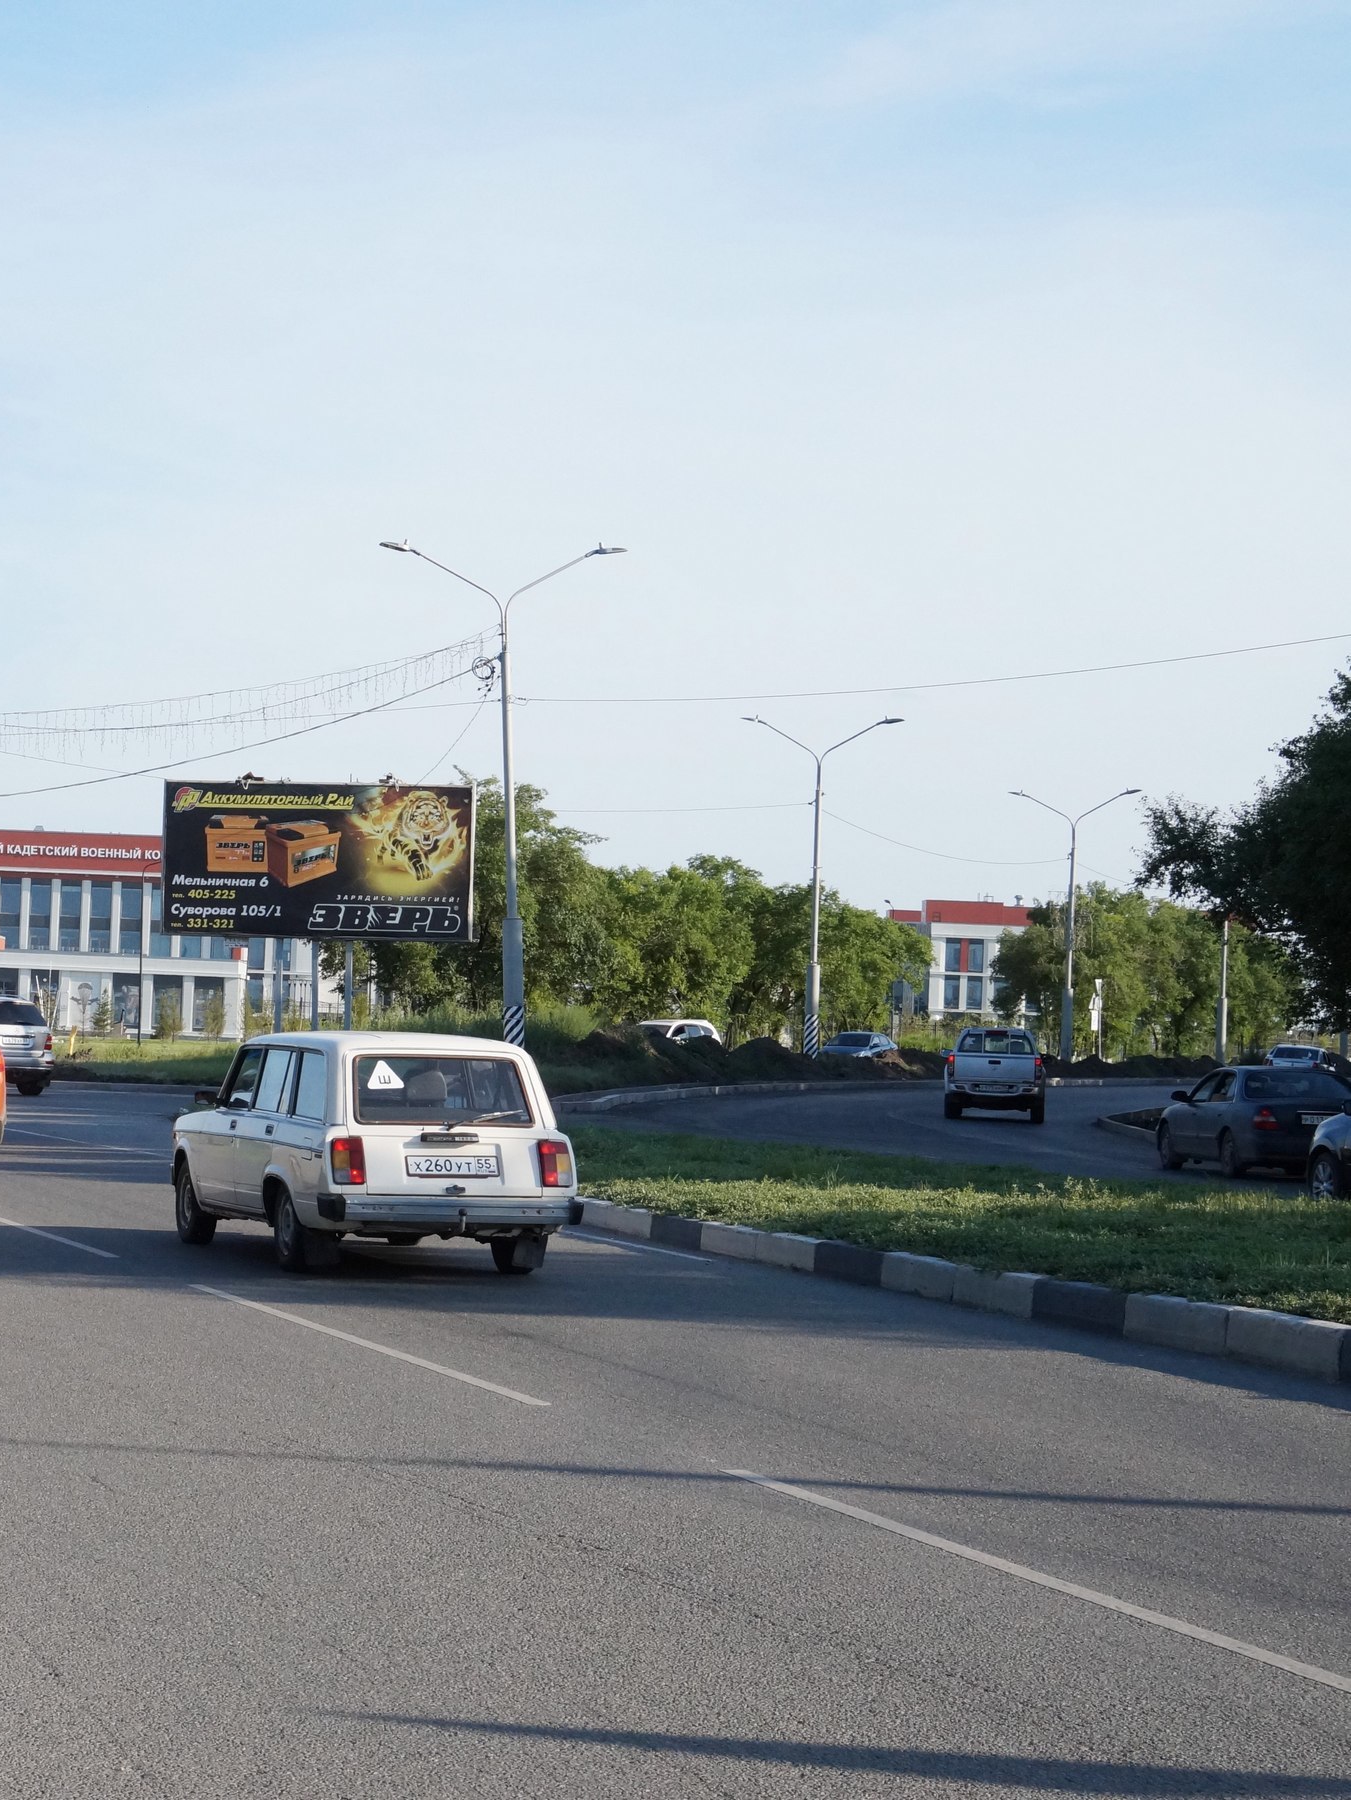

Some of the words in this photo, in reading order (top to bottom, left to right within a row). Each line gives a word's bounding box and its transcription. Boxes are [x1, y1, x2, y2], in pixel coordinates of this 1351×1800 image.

[200, 791, 324, 806] АККУМУЛЯТОРНЫЙ
[6, 844, 78, 857] КАДЕТСКИЙ
[81, 847, 142, 859] ВОЕННЫЙ
[144, 850, 161, 860] КО
[171, 874, 256, 887] Мельничная
[259, 876, 269, 888] 6
[187, 889, 236, 899] 405-225
[399, 895, 460, 903] ЭНЕРГИЕЙ!
[171, 903, 236, 917] Суворова
[240, 904, 282, 917] 105/1
[186, 918, 234, 928] 331-321
[307, 903, 461, 933] ЗВЕРЬ
[378, 1075, 392, 1085] Ш
[477, 1158, 492, 1169] 55
